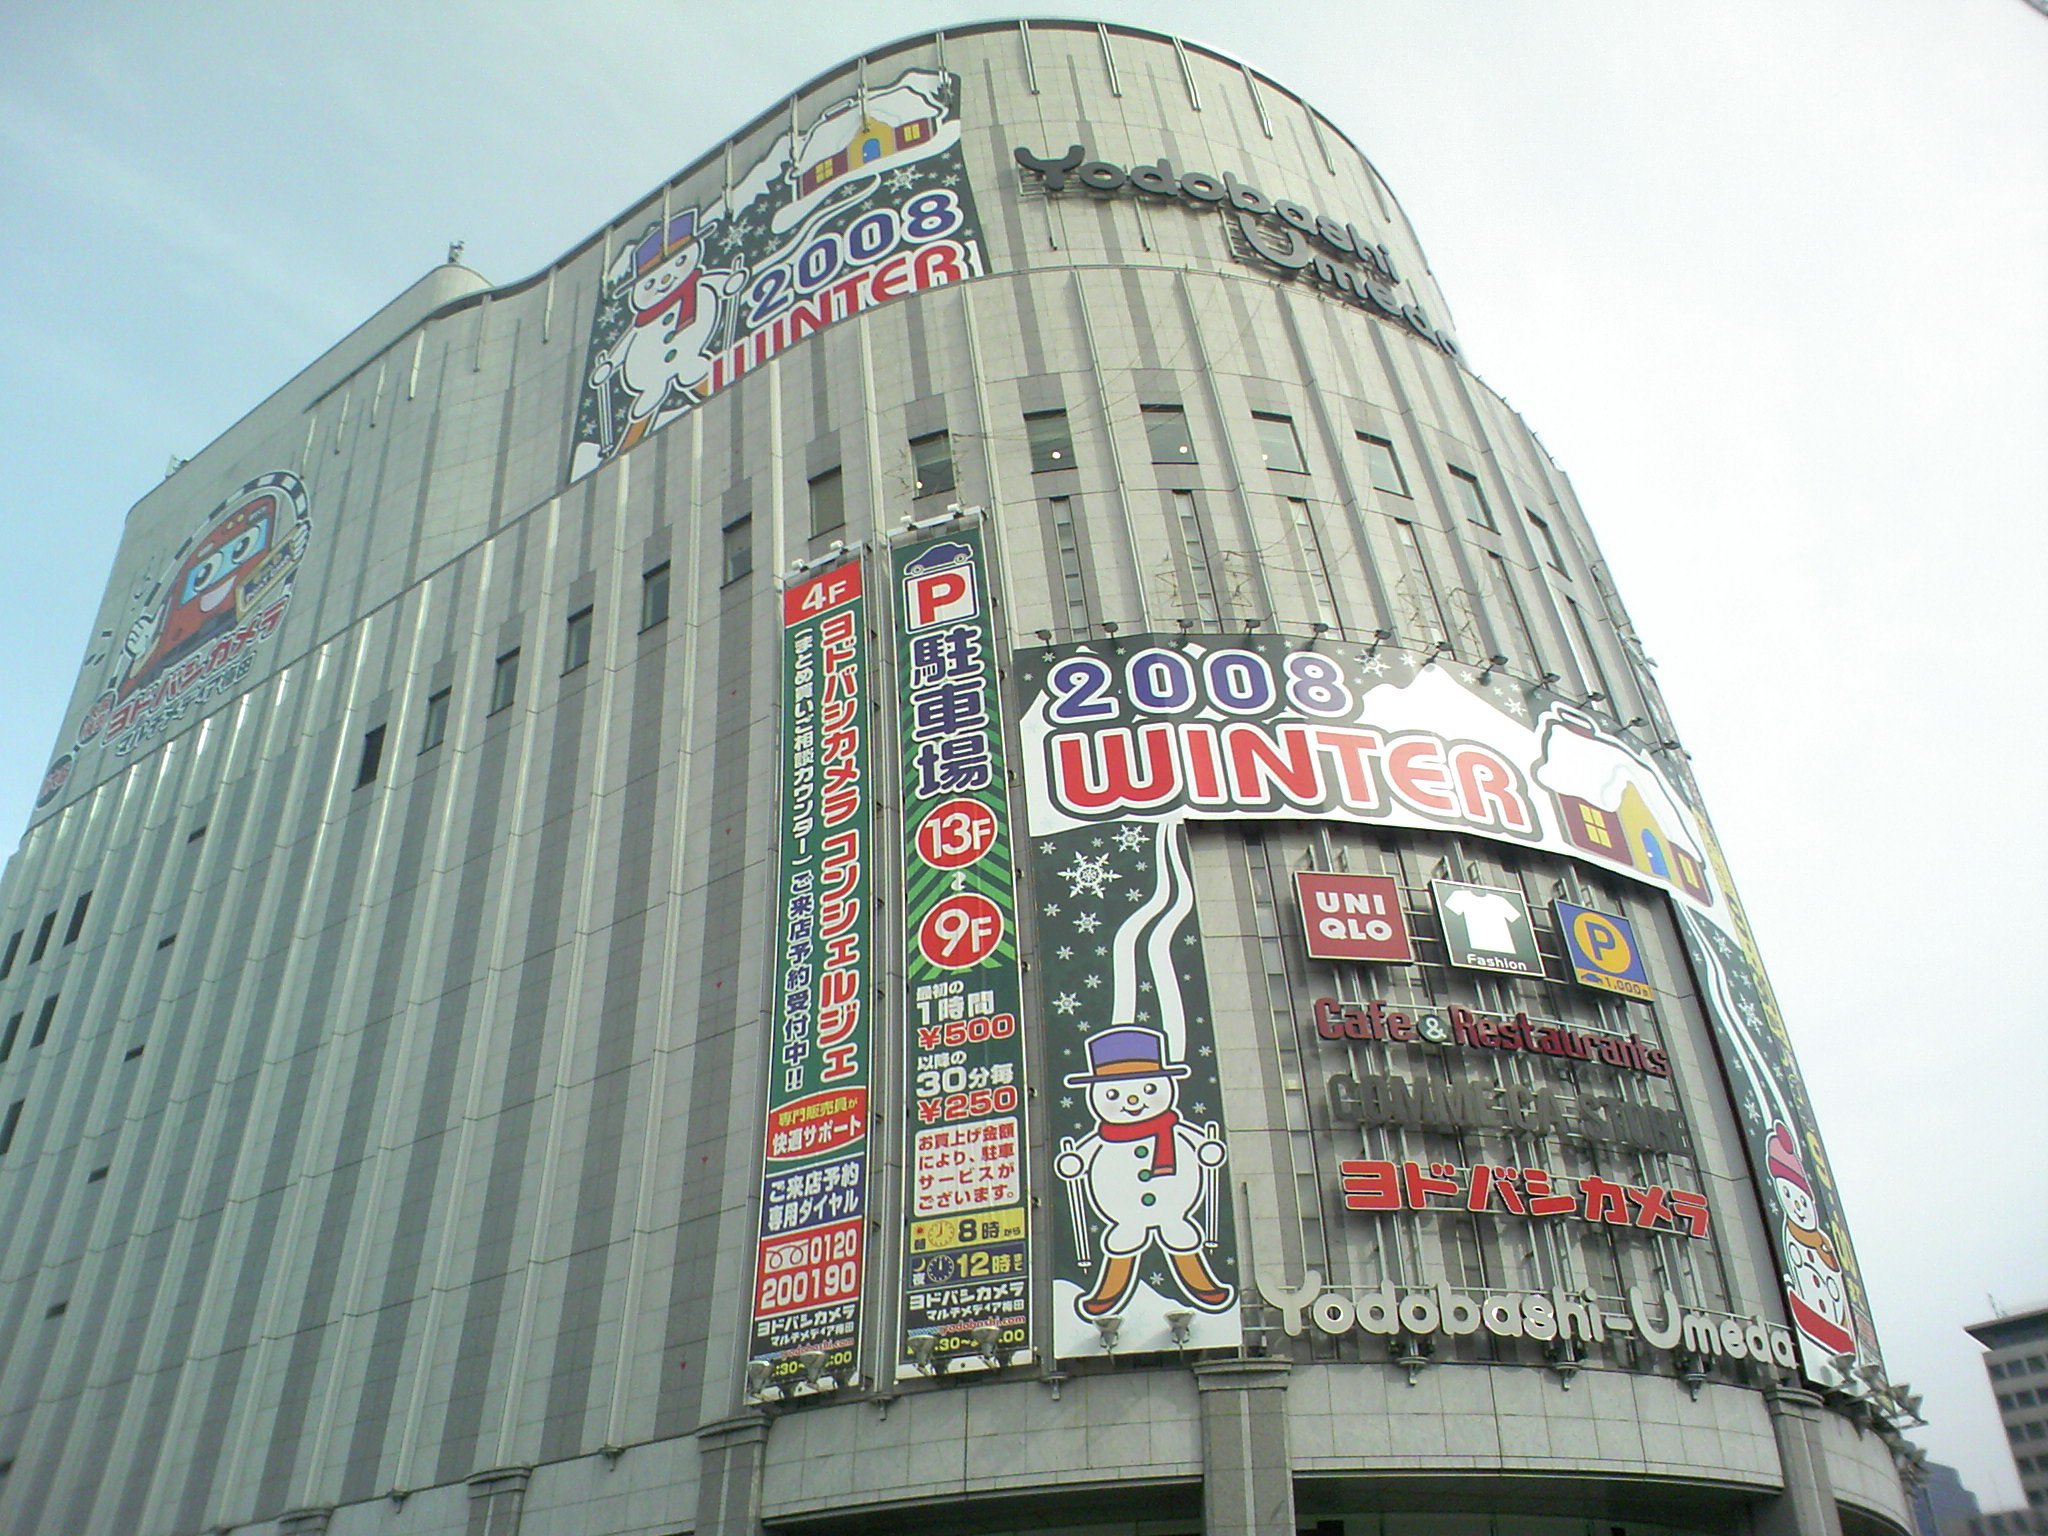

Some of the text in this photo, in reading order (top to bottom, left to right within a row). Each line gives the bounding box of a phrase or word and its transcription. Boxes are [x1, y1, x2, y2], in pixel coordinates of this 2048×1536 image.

[1014, 144, 1400, 284] Yodobashi
[747, 190, 965, 329] 2008
[1239, 213, 1460, 358] Umeda
[801, 580, 847, 611] 4F
[917, 572, 966, 625] P
[1046, 648, 1354, 724] 2008
[820, 610, 861, 828] ヨドバシカメラ
[910, 624, 992, 799] 駐車場
[1051, 723, 1533, 834] WINTER
[925, 812, 991, 859] 13F
[1315, 891, 1386, 915] UNI
[935, 908, 992, 958] 9F
[1319, 917, 1393, 941] QLO
[1584, 920, 1616, 961] P
[1466, 953, 1527, 971] Fashion
[916, 990, 994, 1026] 1時間
[917, 1013, 1015, 1051] ¥500
[1314, 997, 1414, 1043] Cafe
[1447, 1004, 1673, 1077] Restaurants
[916, 1063, 1014, 1098] 30分毎
[917, 1085, 1018, 1124] ¥250
[1327, 1073, 1500, 1129] COMME
[1576, 1092, 1694, 1157] STORE
[772, 1114, 861, 1156] 快適サポート
[769, 1161, 859, 1203] ご来店予約
[918, 1162, 1015, 1190] サービスが
[919, 1184, 1014, 1210] ございます。
[768, 1189, 859, 1231] 専用ダイヤル
[1340, 1159, 1710, 1239] ヨドバシカメラ
[810, 1228, 857, 1263] 0120
[760, 1261, 857, 1310] 200190
[909, 1281, 1025, 1311] ヨドバシカメラ
[757, 1304, 856, 1337] ヨドバシカメラ
[1255, 1269, 1797, 1370] Yodobashi-Umeda
